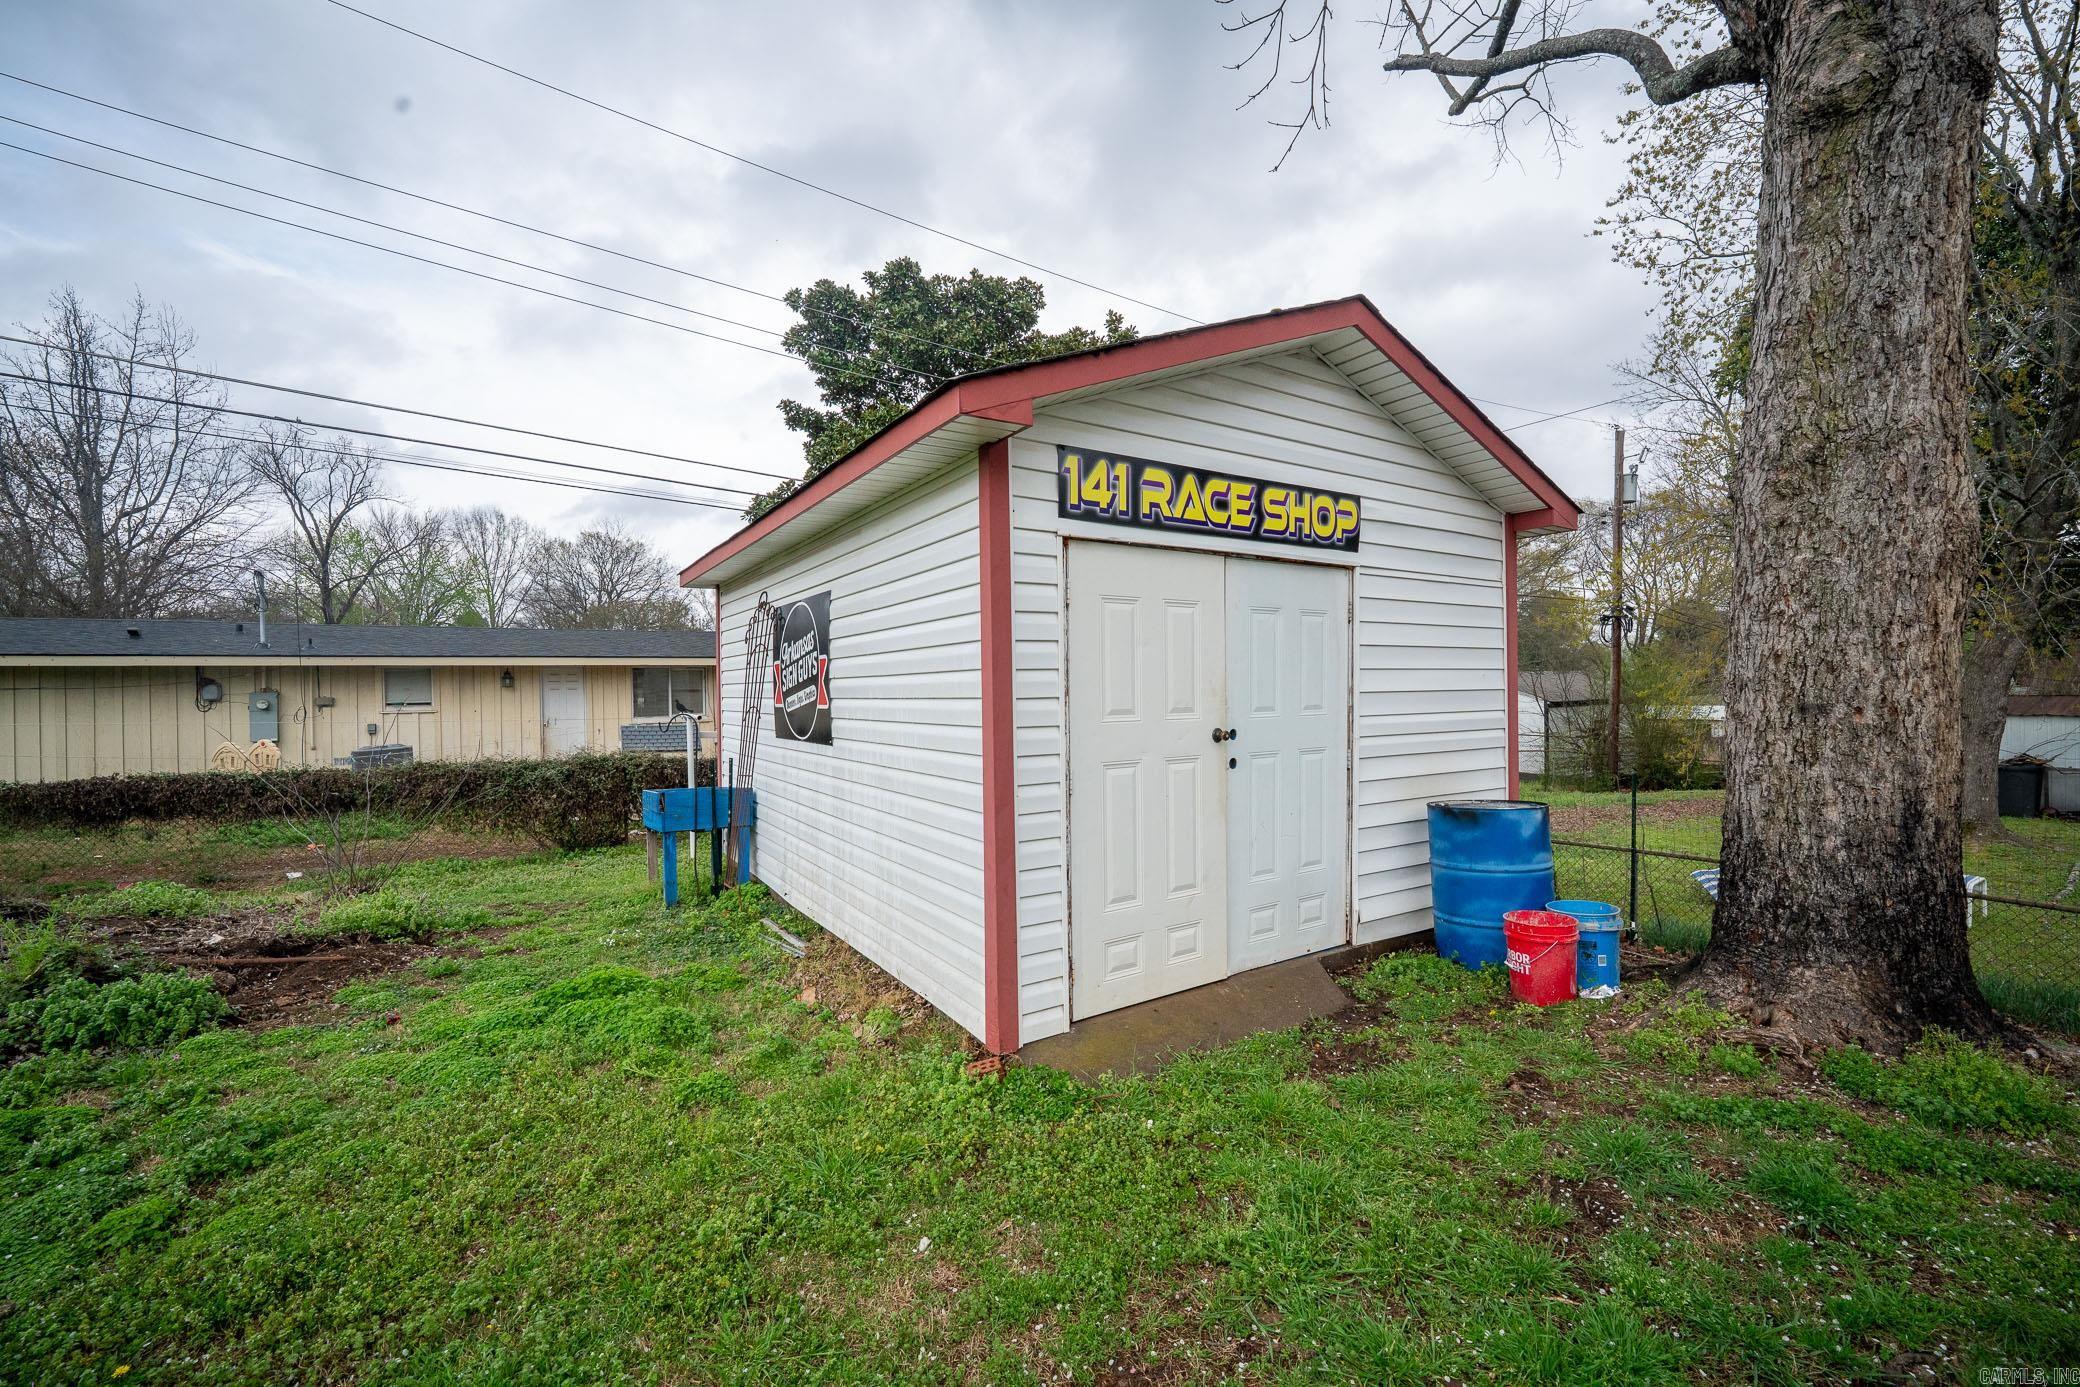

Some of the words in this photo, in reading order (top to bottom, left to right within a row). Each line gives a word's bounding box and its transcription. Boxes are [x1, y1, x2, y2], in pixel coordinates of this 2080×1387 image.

[1063, 455, 1130, 517] 141
[1140, 468, 1256, 533] RACE
[1262, 487, 1360, 544] SHOP
[781, 629, 815, 669] Arkansas
[782, 662, 798, 692] SIGN
[798, 650, 818, 683] GUYS
